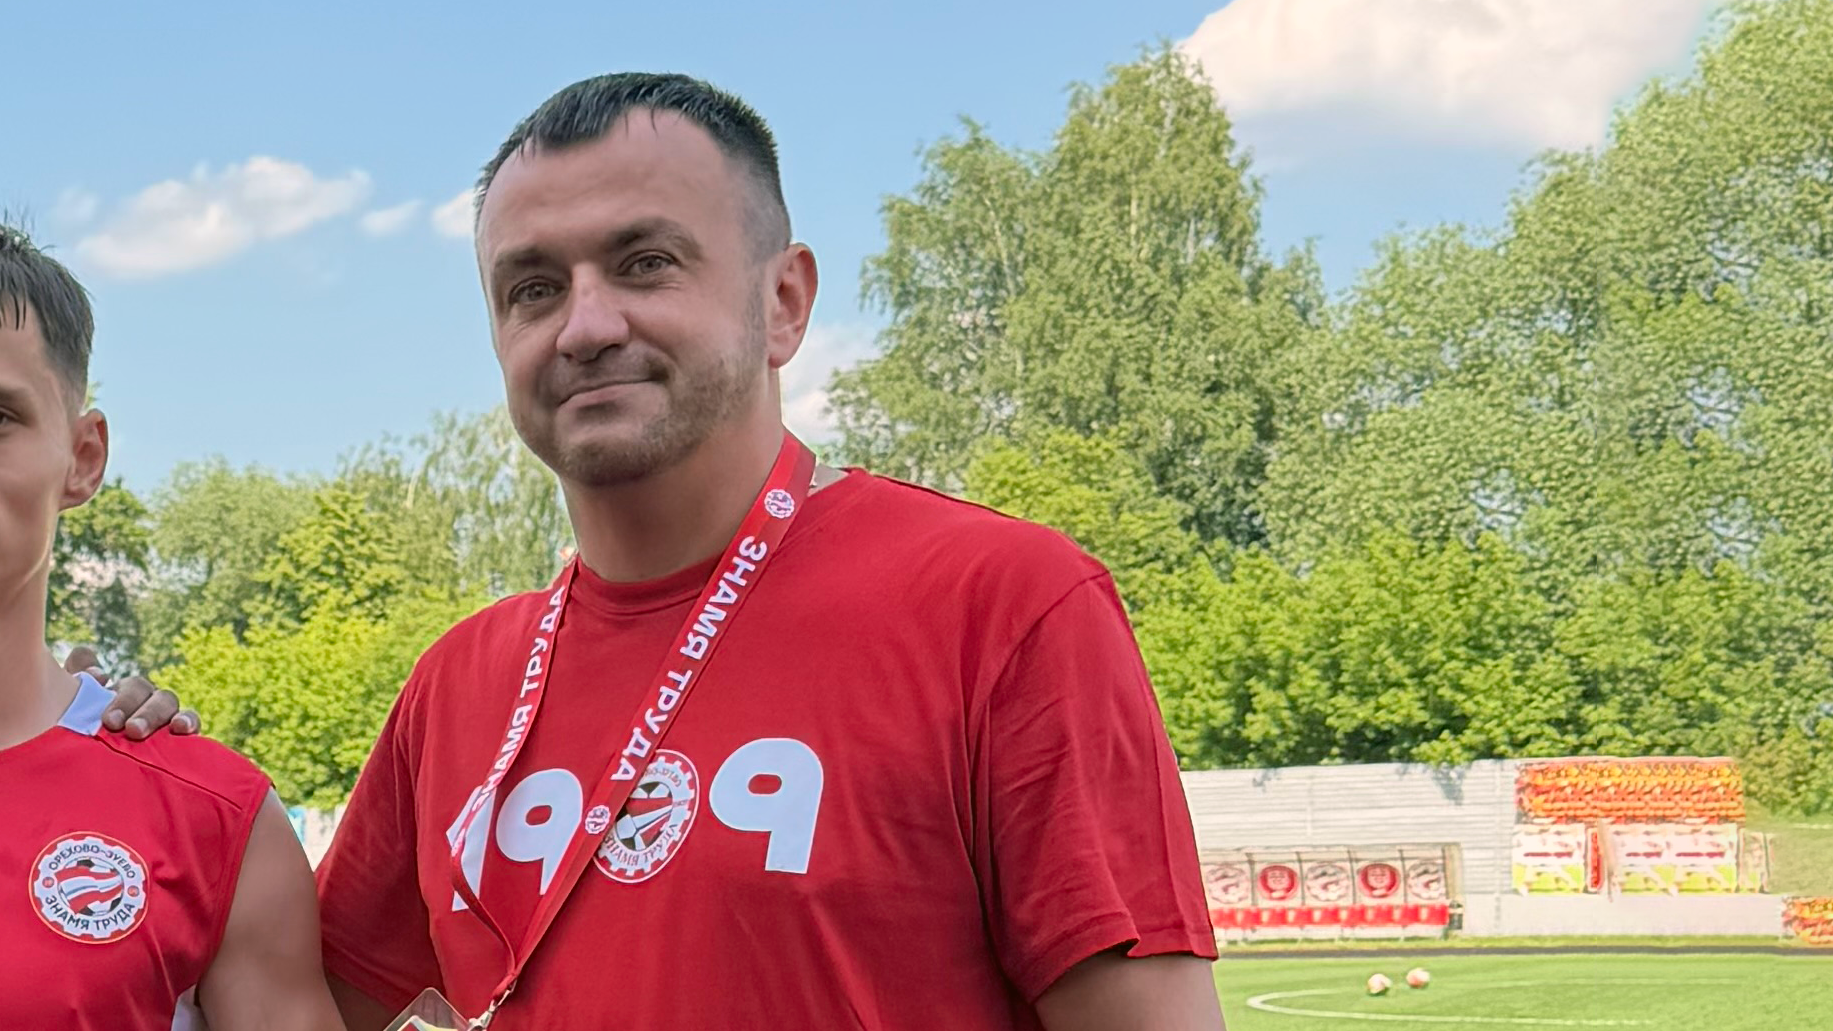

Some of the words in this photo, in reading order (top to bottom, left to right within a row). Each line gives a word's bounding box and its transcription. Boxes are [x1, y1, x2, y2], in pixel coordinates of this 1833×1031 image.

[519, 585, 566, 698] ТРУДА
[679, 535, 768, 660] ЗНАМЯ
[610, 668, 692, 782] ТРУДА
[44, 895, 90, 931] ЗНАМЯ
[94, 902, 135, 931] ТРУДА
[48, 843, 136, 879] ОРЕХОВО-ЗУЕВО
